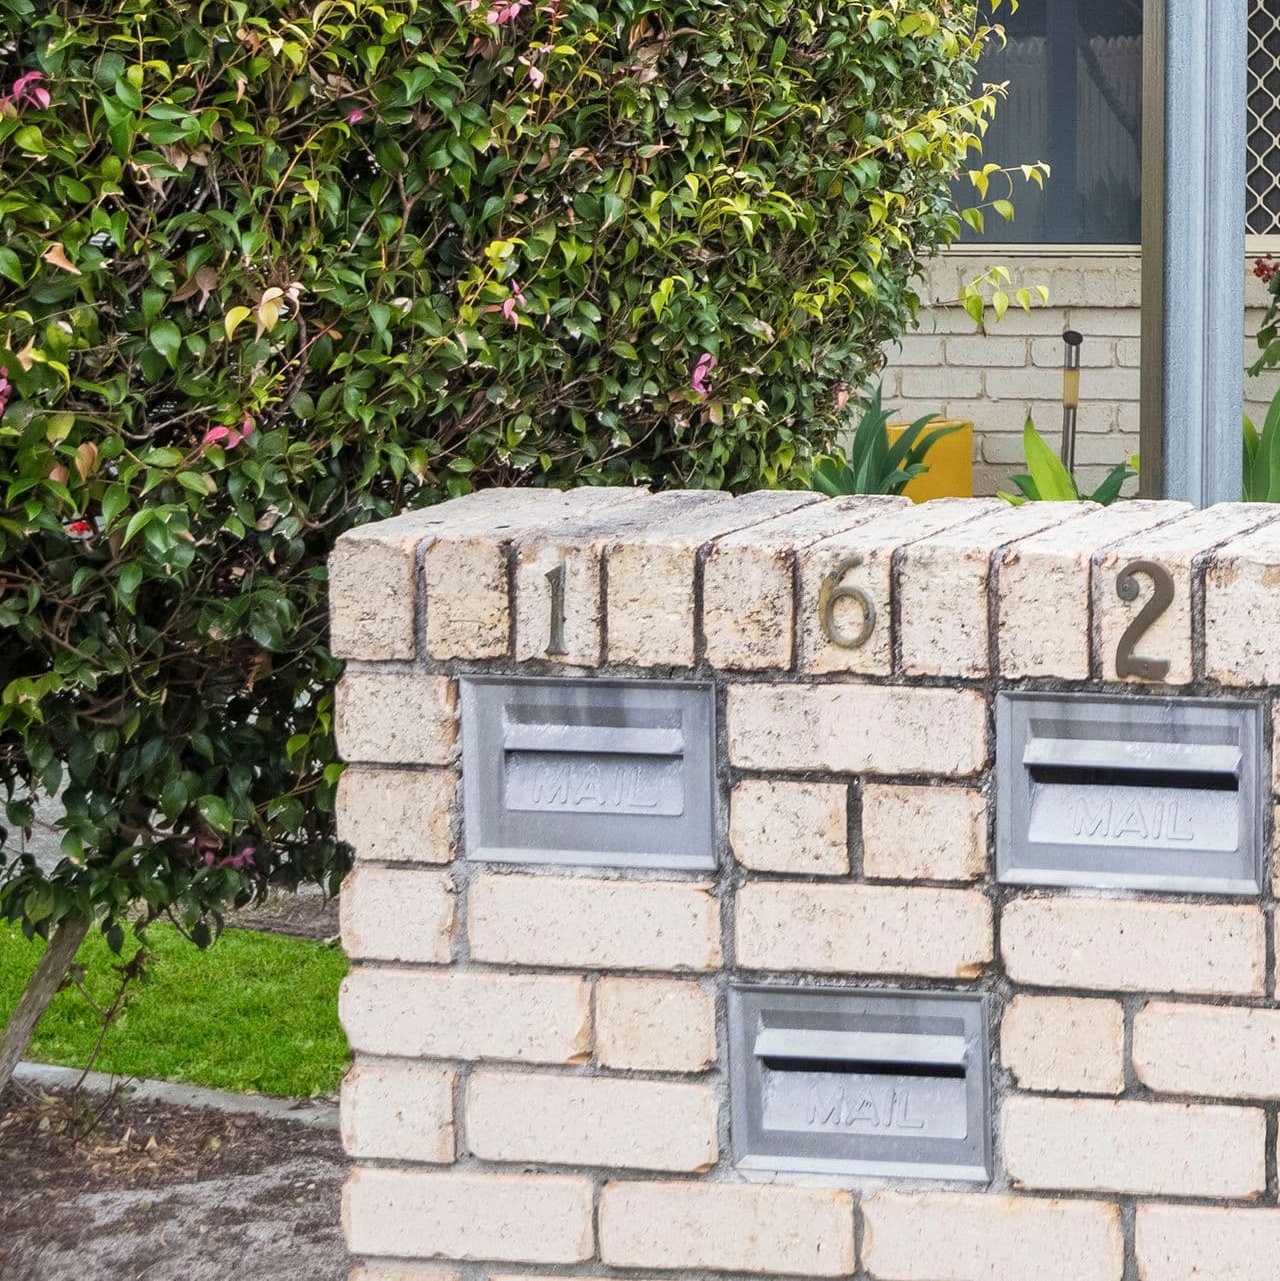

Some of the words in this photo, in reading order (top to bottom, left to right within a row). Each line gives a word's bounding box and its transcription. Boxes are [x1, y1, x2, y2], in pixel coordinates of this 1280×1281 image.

[532, 763, 657, 807] MAIL
[1073, 796, 1194, 840] MAIL
[807, 1086, 925, 1129] MAIL
